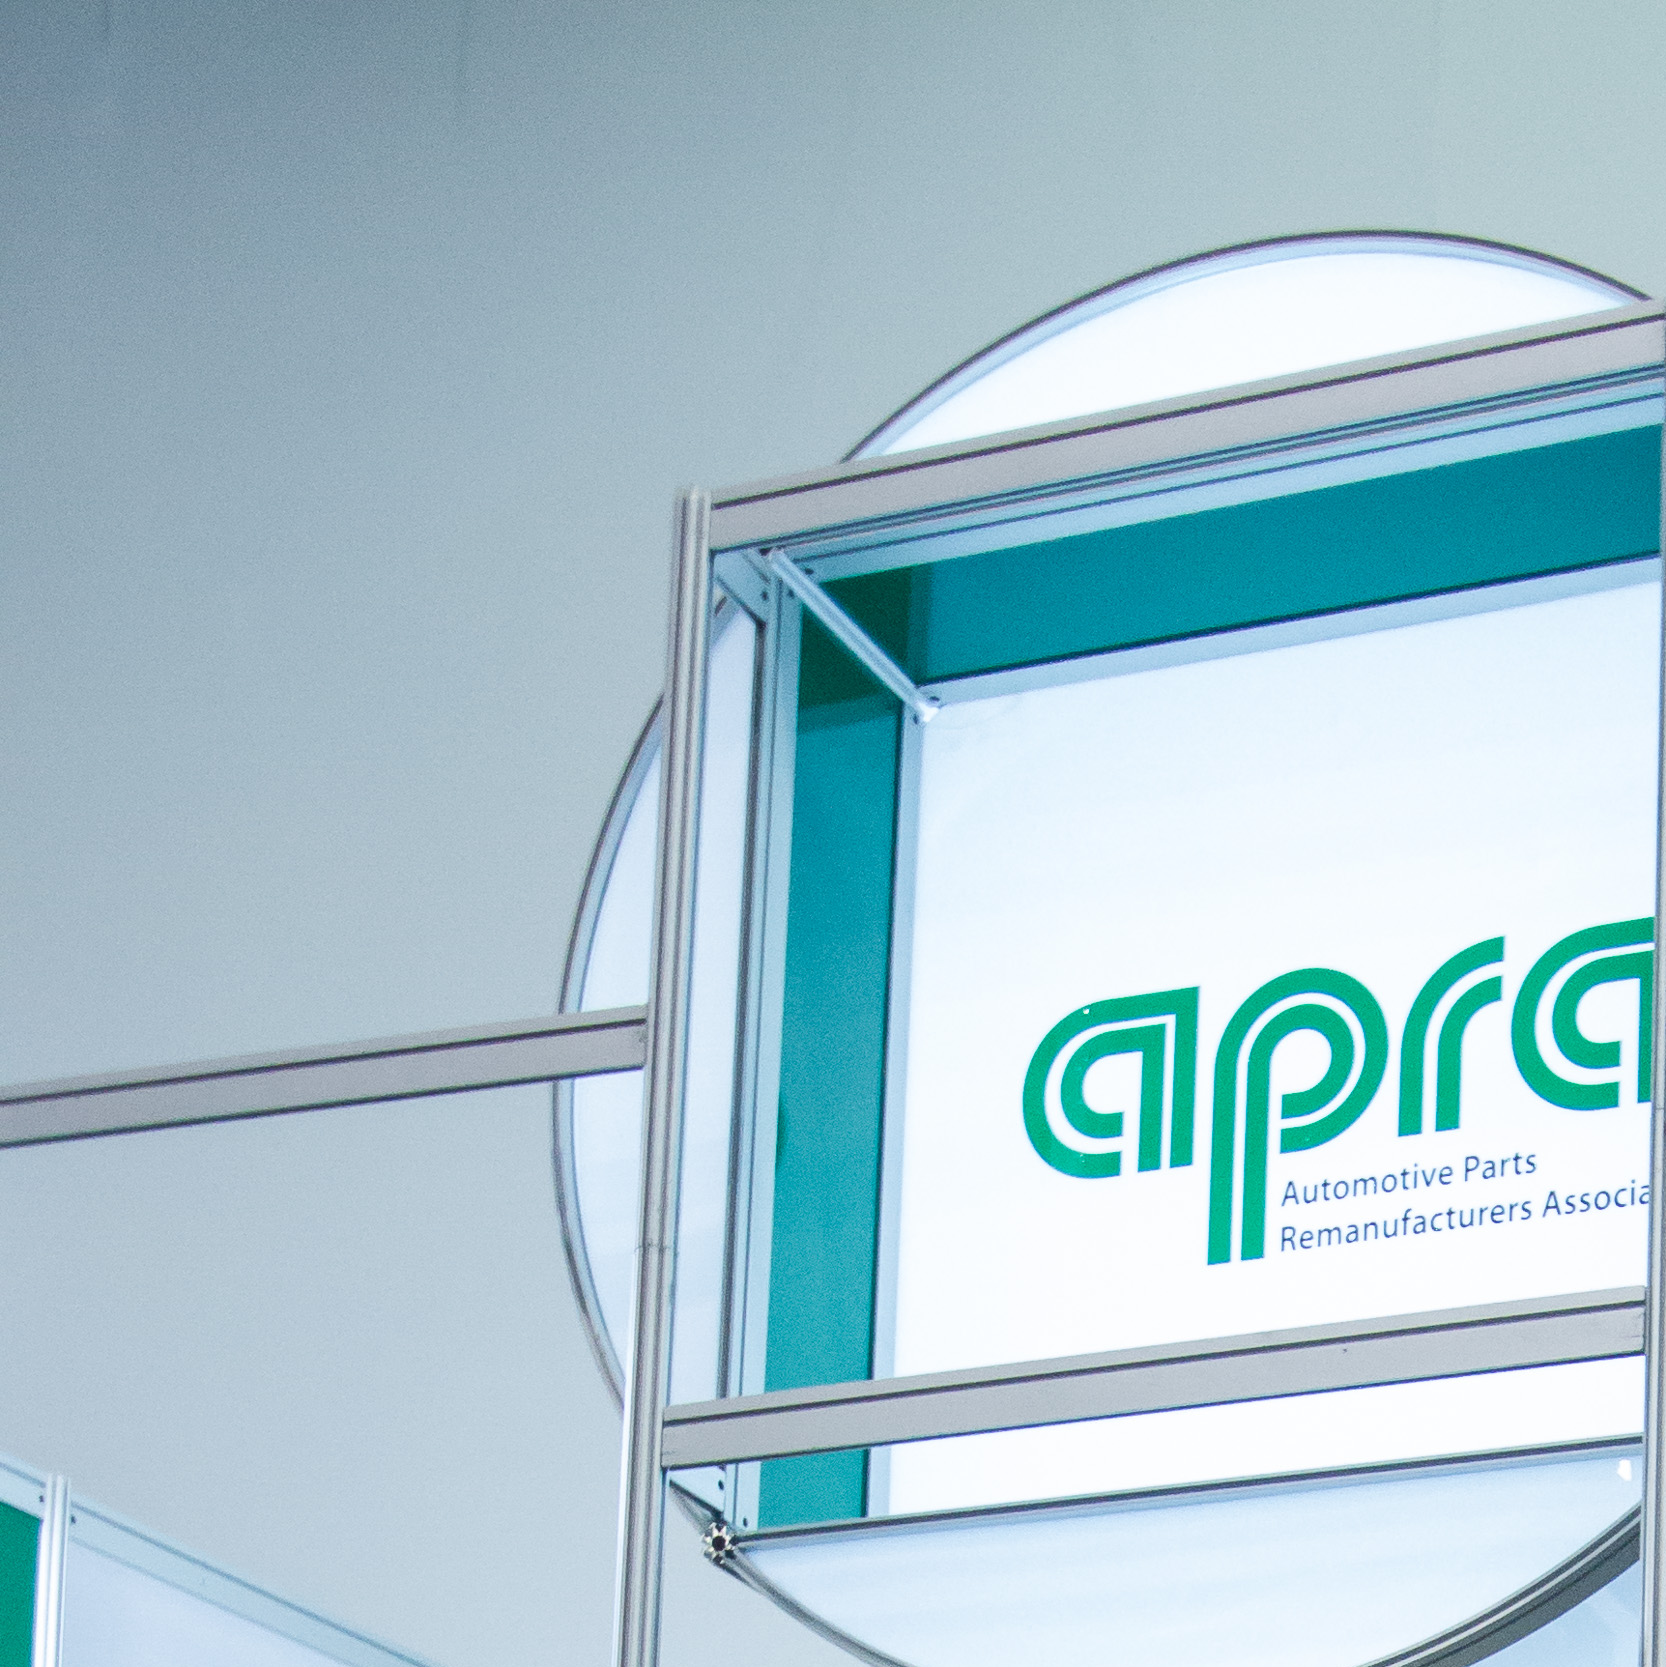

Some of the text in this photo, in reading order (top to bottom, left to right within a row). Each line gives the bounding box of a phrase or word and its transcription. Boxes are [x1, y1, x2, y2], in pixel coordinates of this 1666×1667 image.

[1023, 916, 1655, 1266] apra
[1281, 1152, 1537, 1207] Automotive Parts
[1281, 1199, 1532, 1252] Remanufacturers
